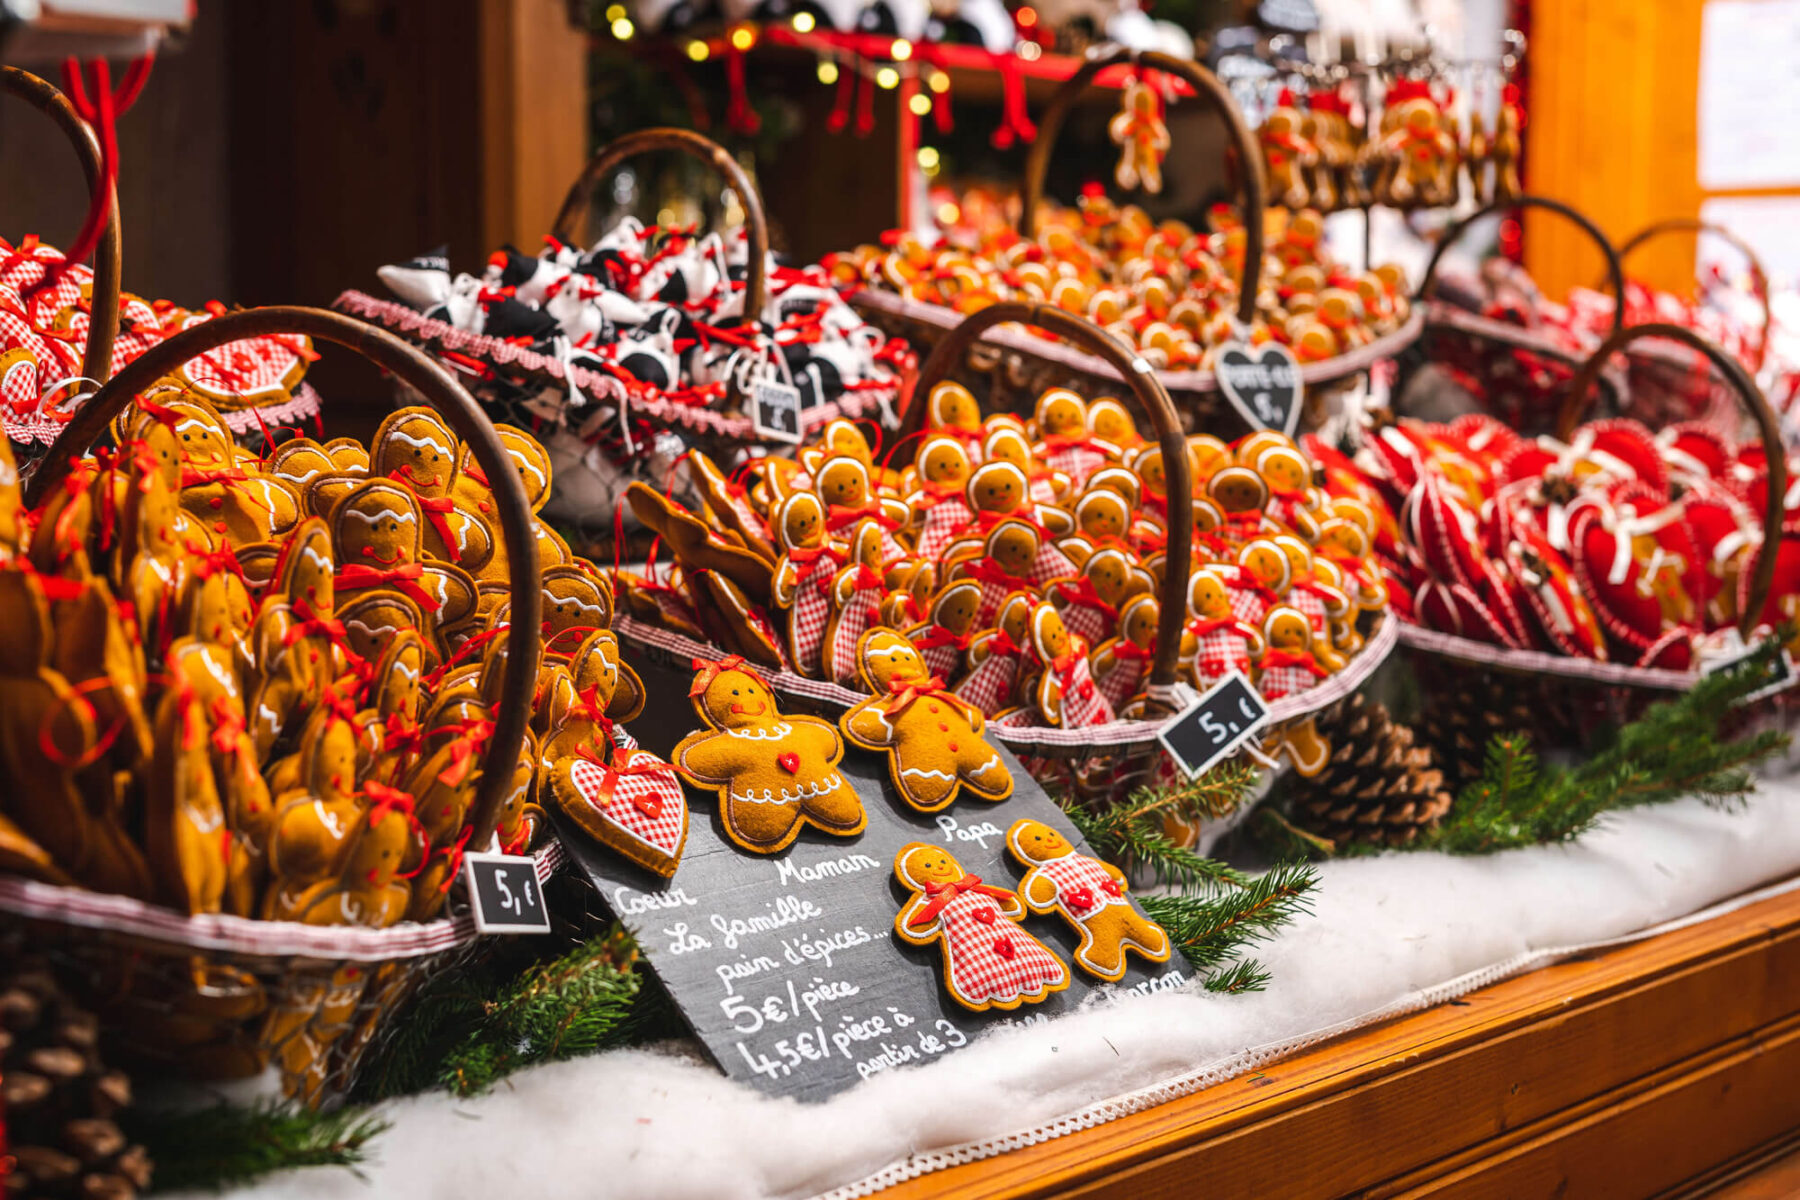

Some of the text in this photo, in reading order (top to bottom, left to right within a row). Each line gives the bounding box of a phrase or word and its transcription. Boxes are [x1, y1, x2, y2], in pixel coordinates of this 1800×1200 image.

[936, 815, 1003, 849] Papa
[773, 854, 881, 886] Maman
[614, 886, 698, 915] Coeur
[663, 895, 823, 955] La famille
[716, 953, 780, 995] pain
[886, 1006, 915, 1028] à
[856, 1018, 968, 1080] partir de 3
